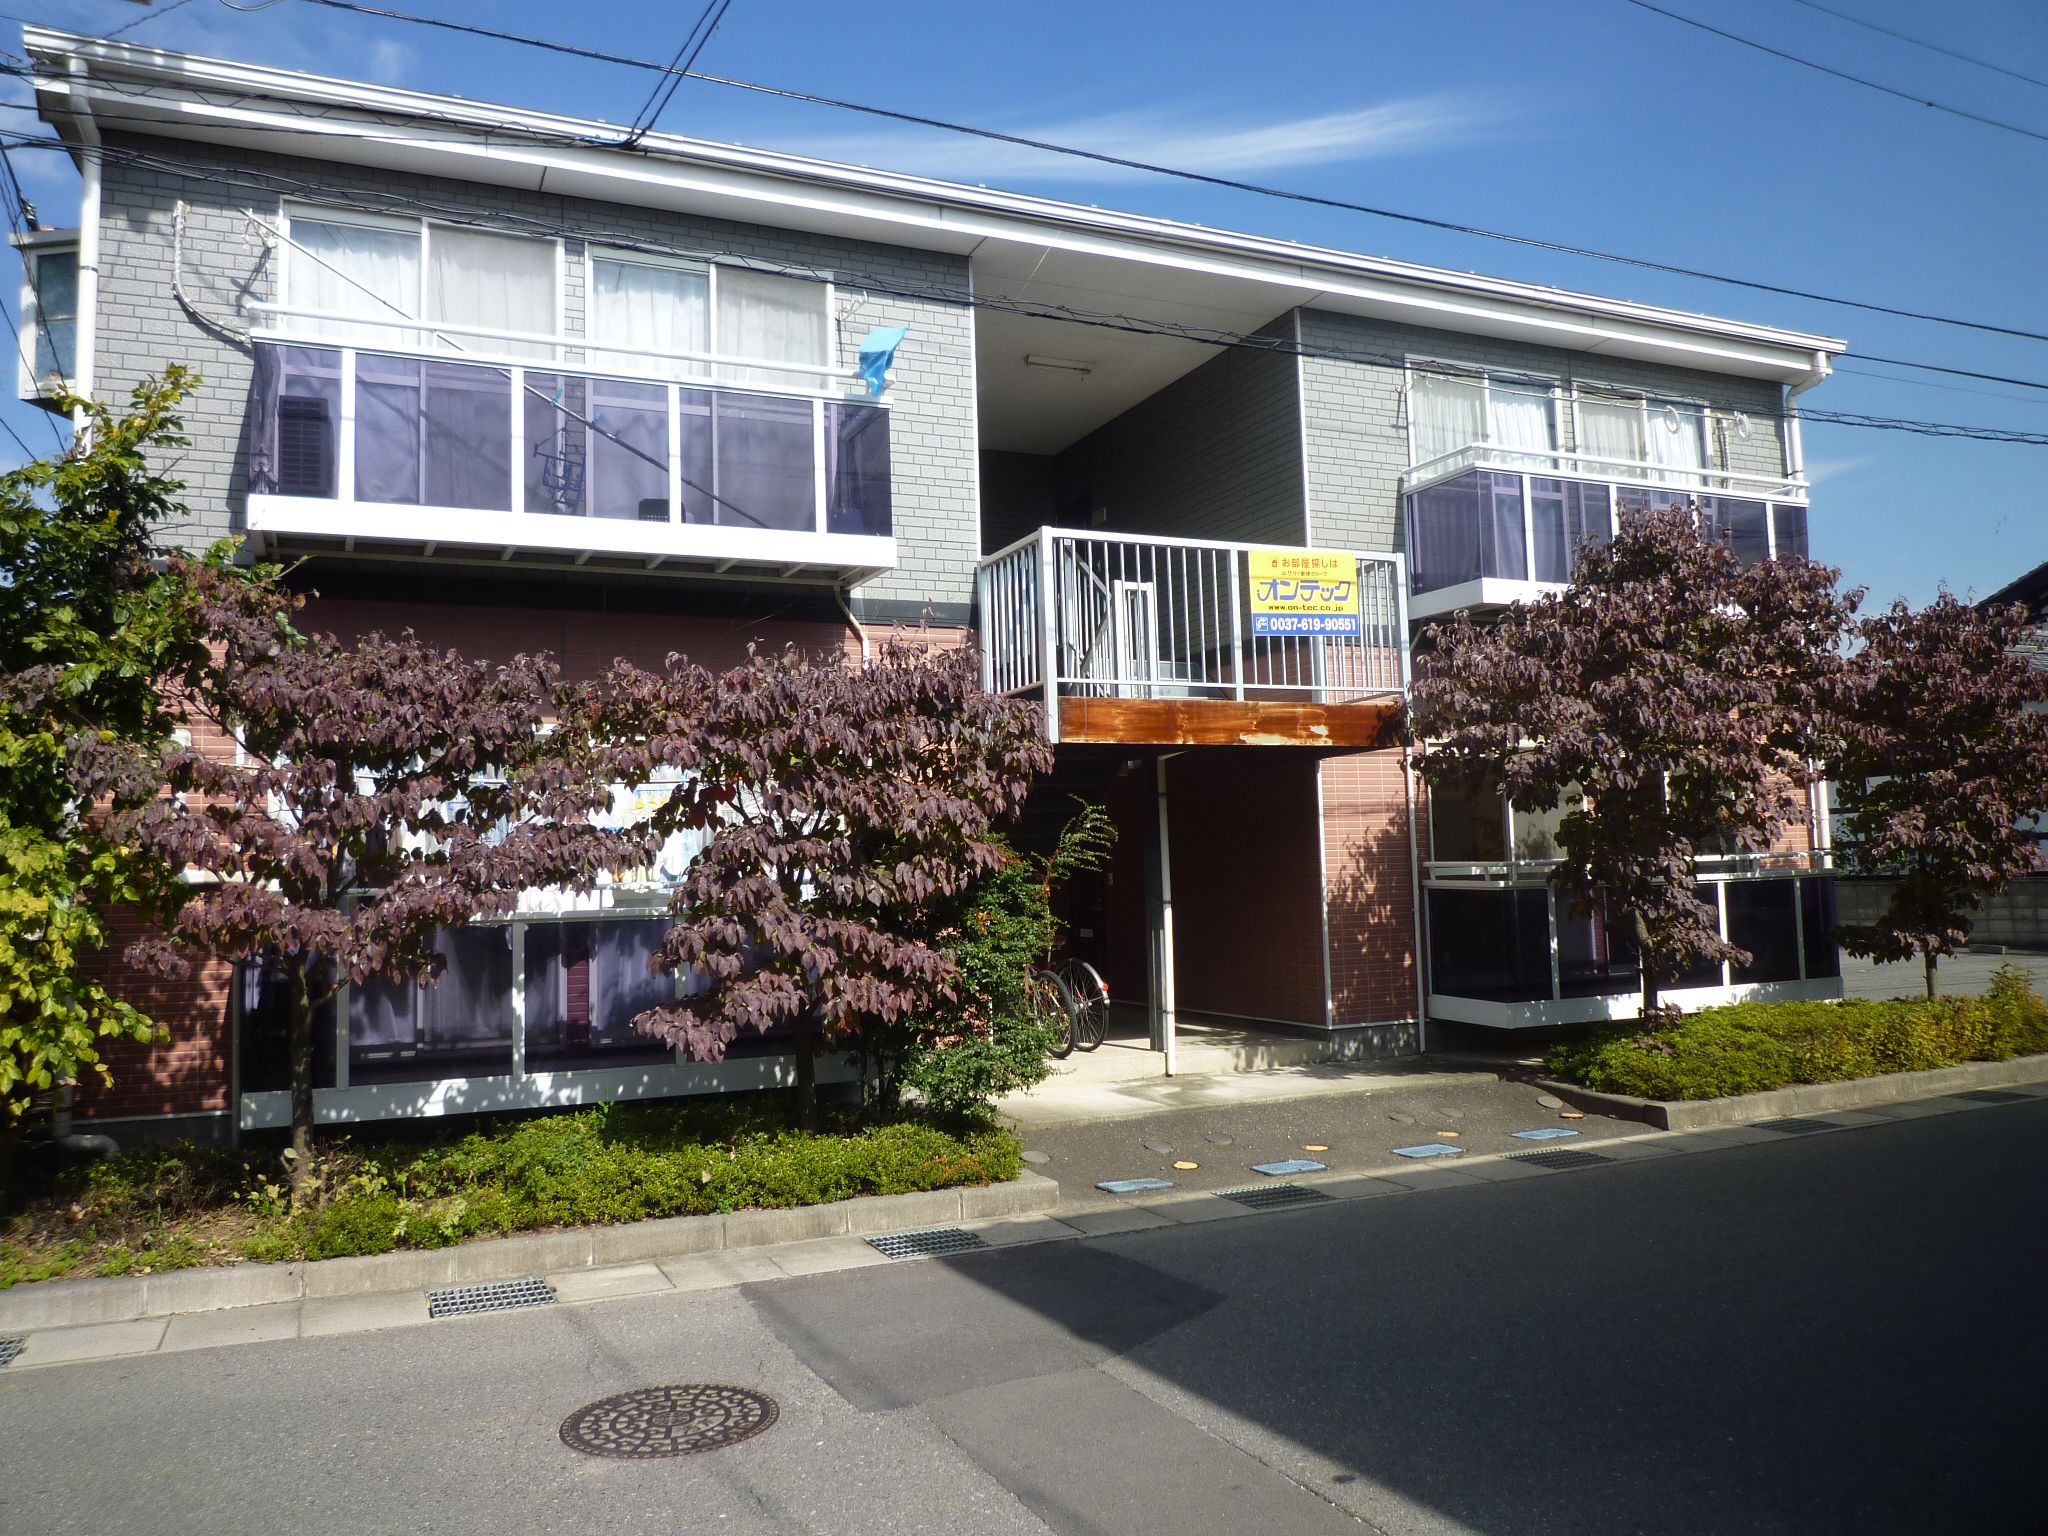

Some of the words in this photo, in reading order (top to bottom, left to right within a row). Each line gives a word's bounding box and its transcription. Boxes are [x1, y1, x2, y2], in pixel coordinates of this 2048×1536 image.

[1282, 558, 1338, 568] お部屋探しは
[1256, 579, 1351, 601] オンテック
[1270, 617, 1356, 631] 0037-619-90551
